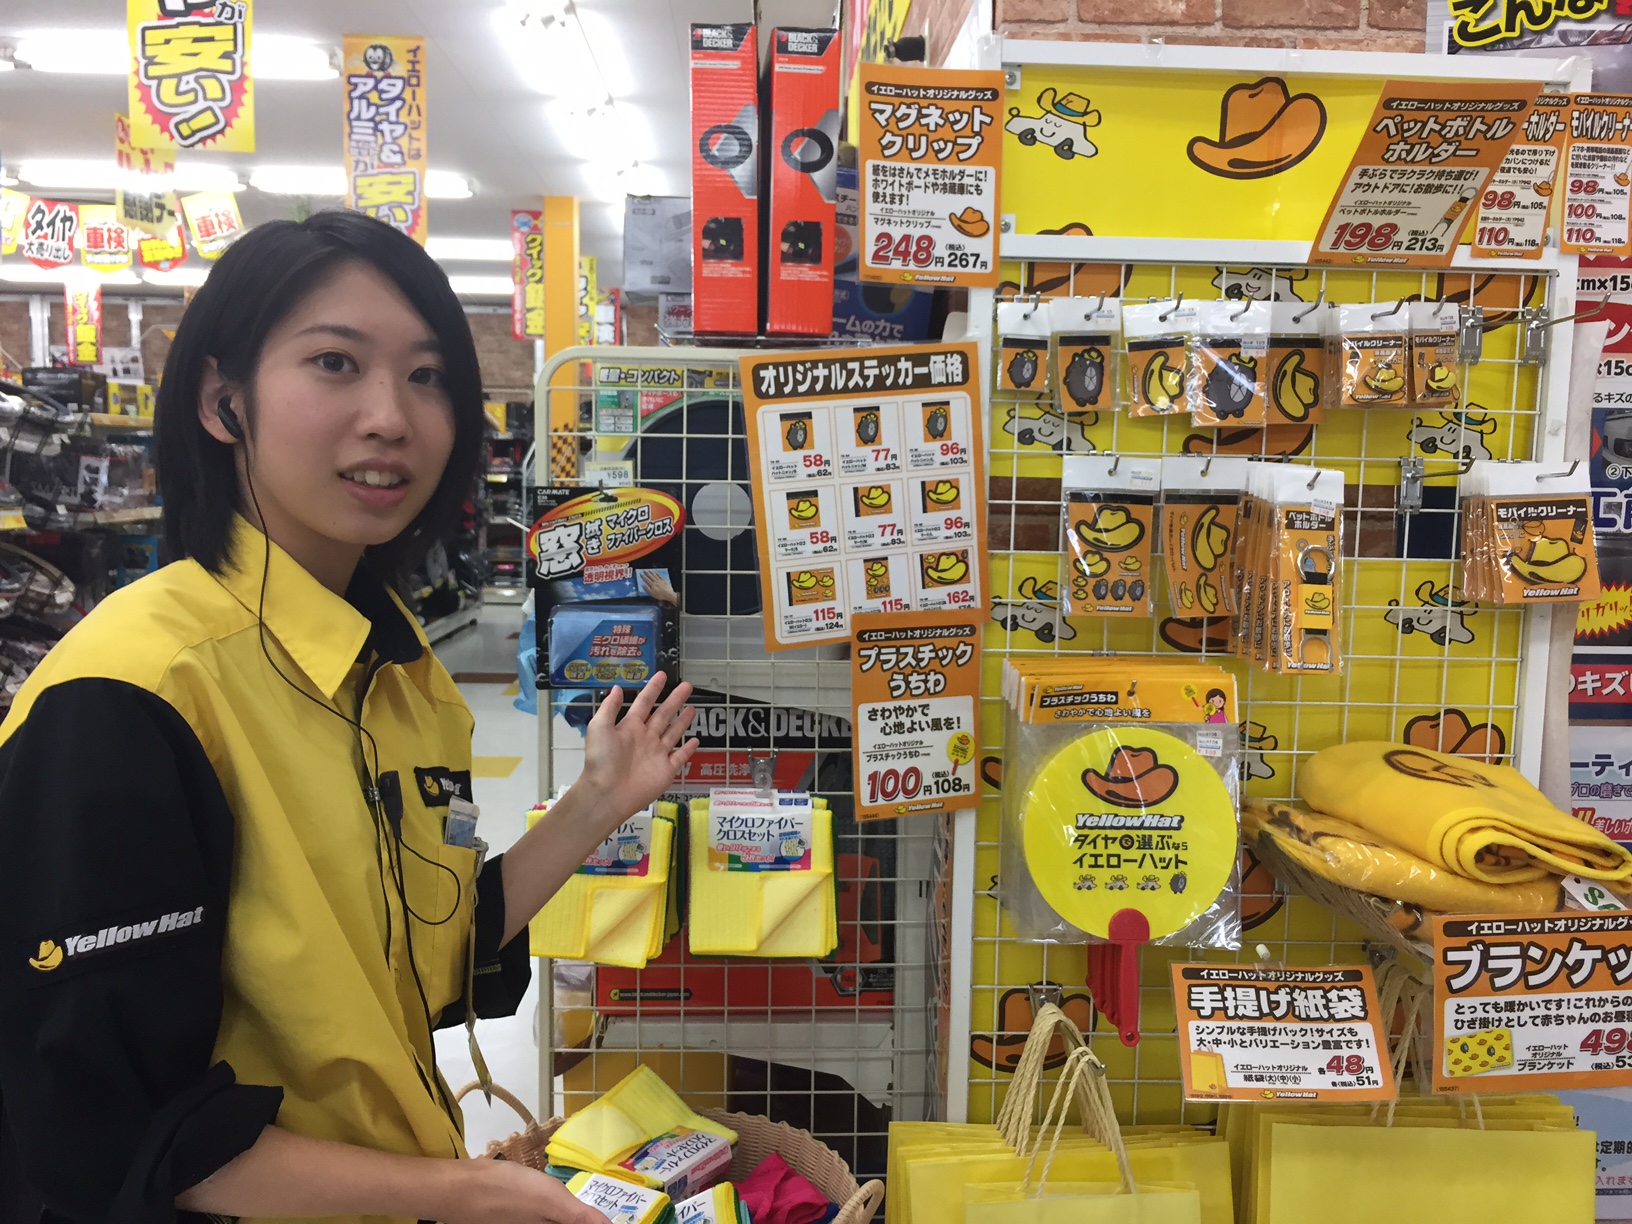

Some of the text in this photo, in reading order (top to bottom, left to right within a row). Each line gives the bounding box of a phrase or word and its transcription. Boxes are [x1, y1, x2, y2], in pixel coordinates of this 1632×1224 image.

[702, 38, 734, 47] DECKER
[788, 43, 818, 52] DECKER
[871, 85, 993, 100] イエローハットオリジナルグッズ
[1389, 98, 1522, 112] イエローハットオリジナルグッズ
[868, 100, 994, 132] マグネット
[1373, 114, 1517, 142] ペットボトル
[879, 130, 983, 161] クリップ
[1383, 141, 1480, 164] ホルダー
[872, 164, 988, 182] 紙をはさんでメモホルダーに!
[1357, 168, 1480, 182] 手ぶらでラクラク持ち運び!
[872, 179, 983, 196] ホワイトボードや冷蔵庫にも
[872, 193, 910, 206] 使えます!
[31, 202, 76, 242] タイヤ
[759, 354, 963, 396] オリジナルステッカー価格
[605, 504, 650, 530] マイクロ
[1294, 520, 1327, 530] ホルダー
[605, 517, 674, 550] ファイバークロス
[1522, 586, 1580, 598] YellowHat
[862, 626, 971, 641] イエローハットオリジナルグッズ
[858, 641, 974, 672] プラスチック
[888, 669, 946, 698] うちわ
[1042, 693, 1117, 706] プラスチックうちわ
[867, 703, 930, 721] さわやかで
[684, 707, 853, 738] ACK&DECKE
[880, 717, 961, 736] 心地よい風を!
[866, 750, 920, 763] プラスチックうちわ
[716, 815, 804, 830] マイクロファイバー
[1075, 813, 1185, 831] YellowHat
[716, 829, 775, 843] クロスセット
[1072, 835, 1189, 852] タイヤで選ぶなら
[1072, 853, 1189, 870] イエローハット
[65, 905, 205, 957] YellowHat
[1200, 969, 1345, 983] イエローハットオリジナルグッズ
[1187, 983, 1369, 1021] 手提げ紙袋
[1195, 1025, 1359, 1038] シンプルな手提げバック!サイズも
[1196, 1037, 1371, 1051] 大・中・小とバリエーション豊富です!
[1517, 1059, 1574, 1072] ブランケット
[1275, 1090, 1319, 1100] YellowHat
[585, 1179, 647, 1205] マイクロファイバー
